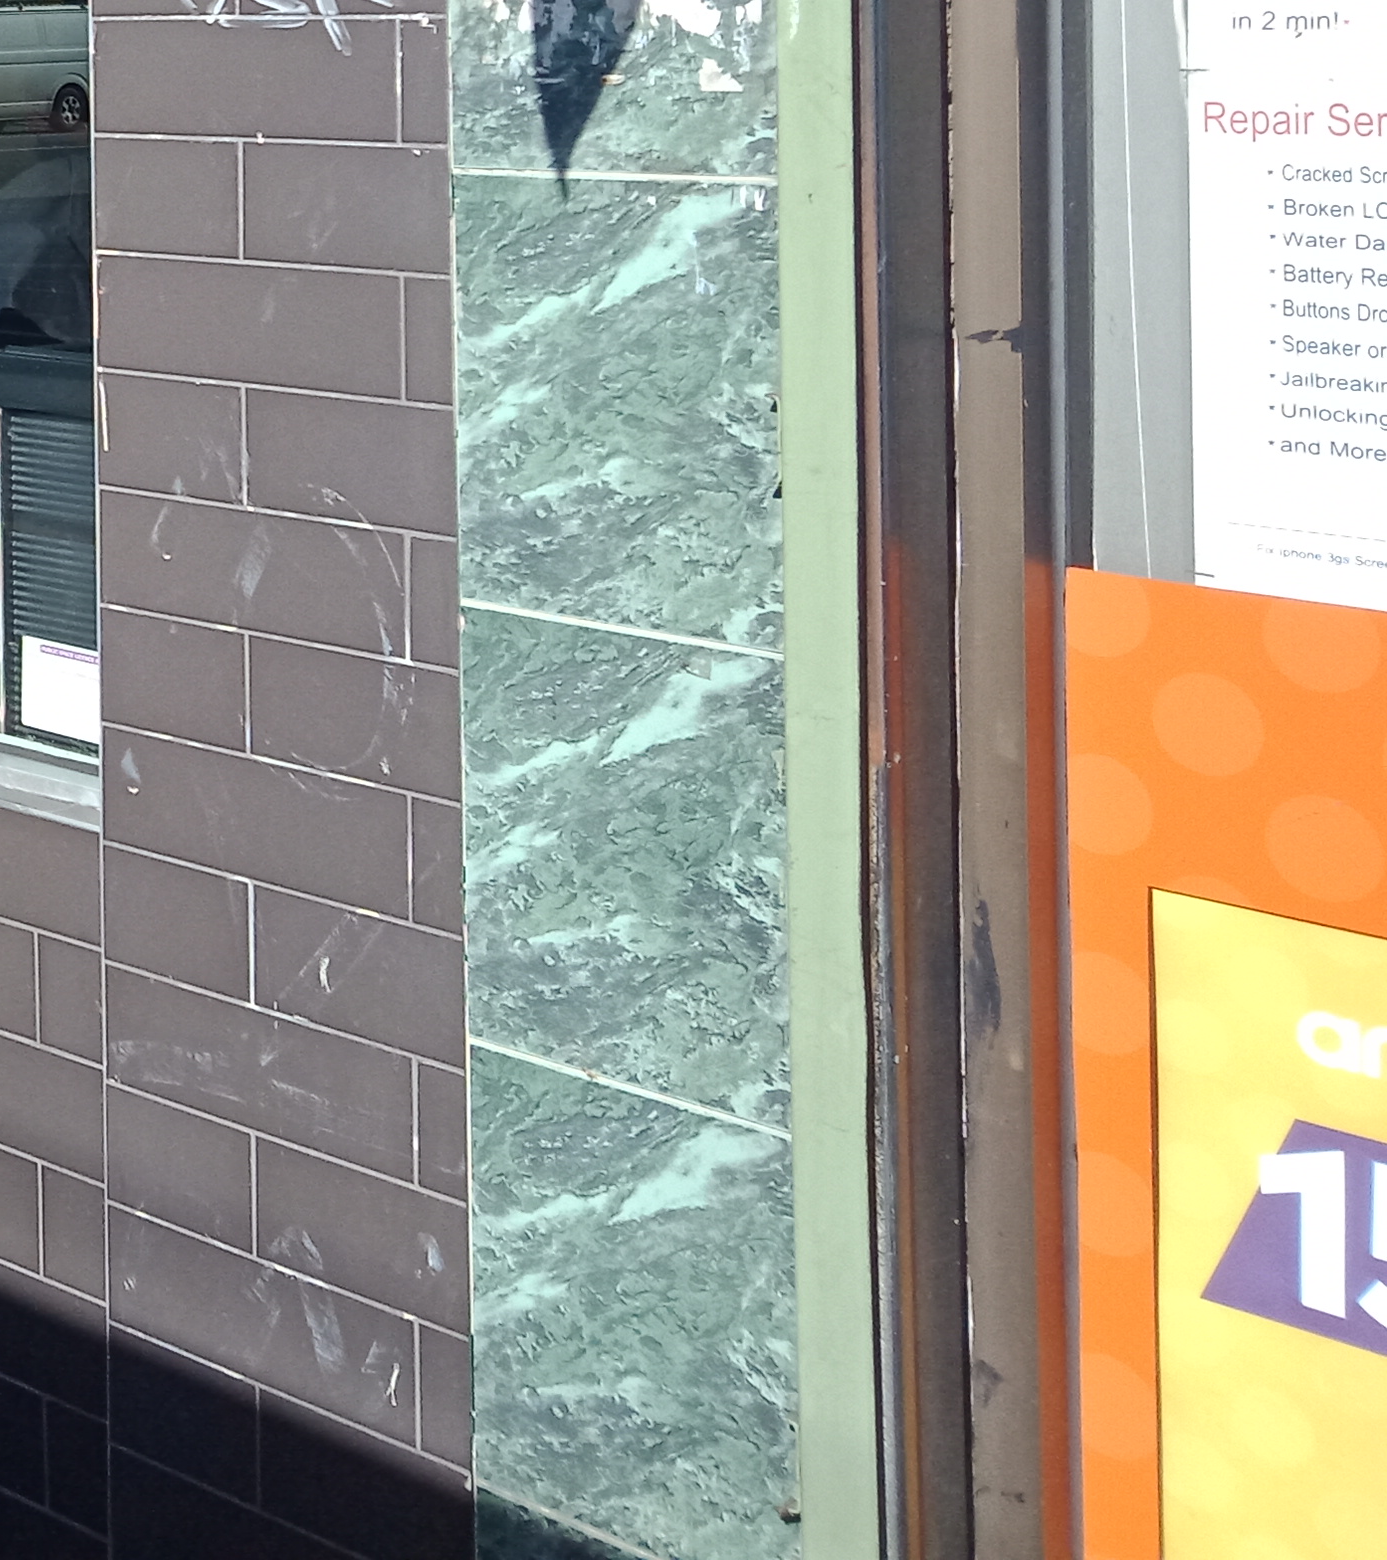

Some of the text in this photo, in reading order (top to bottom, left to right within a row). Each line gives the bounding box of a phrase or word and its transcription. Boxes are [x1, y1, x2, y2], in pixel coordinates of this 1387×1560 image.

[1232, 11, 1252, 30] in
[1261, 11, 1277, 30] 2
[1204, 101, 1315, 142] Repair
[1282, 163, 1353, 183] Cracked
[1284, 198, 1354, 218] Broken
[1282, 231, 1386, 251] Water Da
[1283, 263, 1353, 290] Battery
[1283, 299, 1350, 321] Buttons
[1282, 334, 1361, 357] Speaker
[1280, 403, 1387, 431] Unlocking
[1280, 440, 1387, 461] and More
